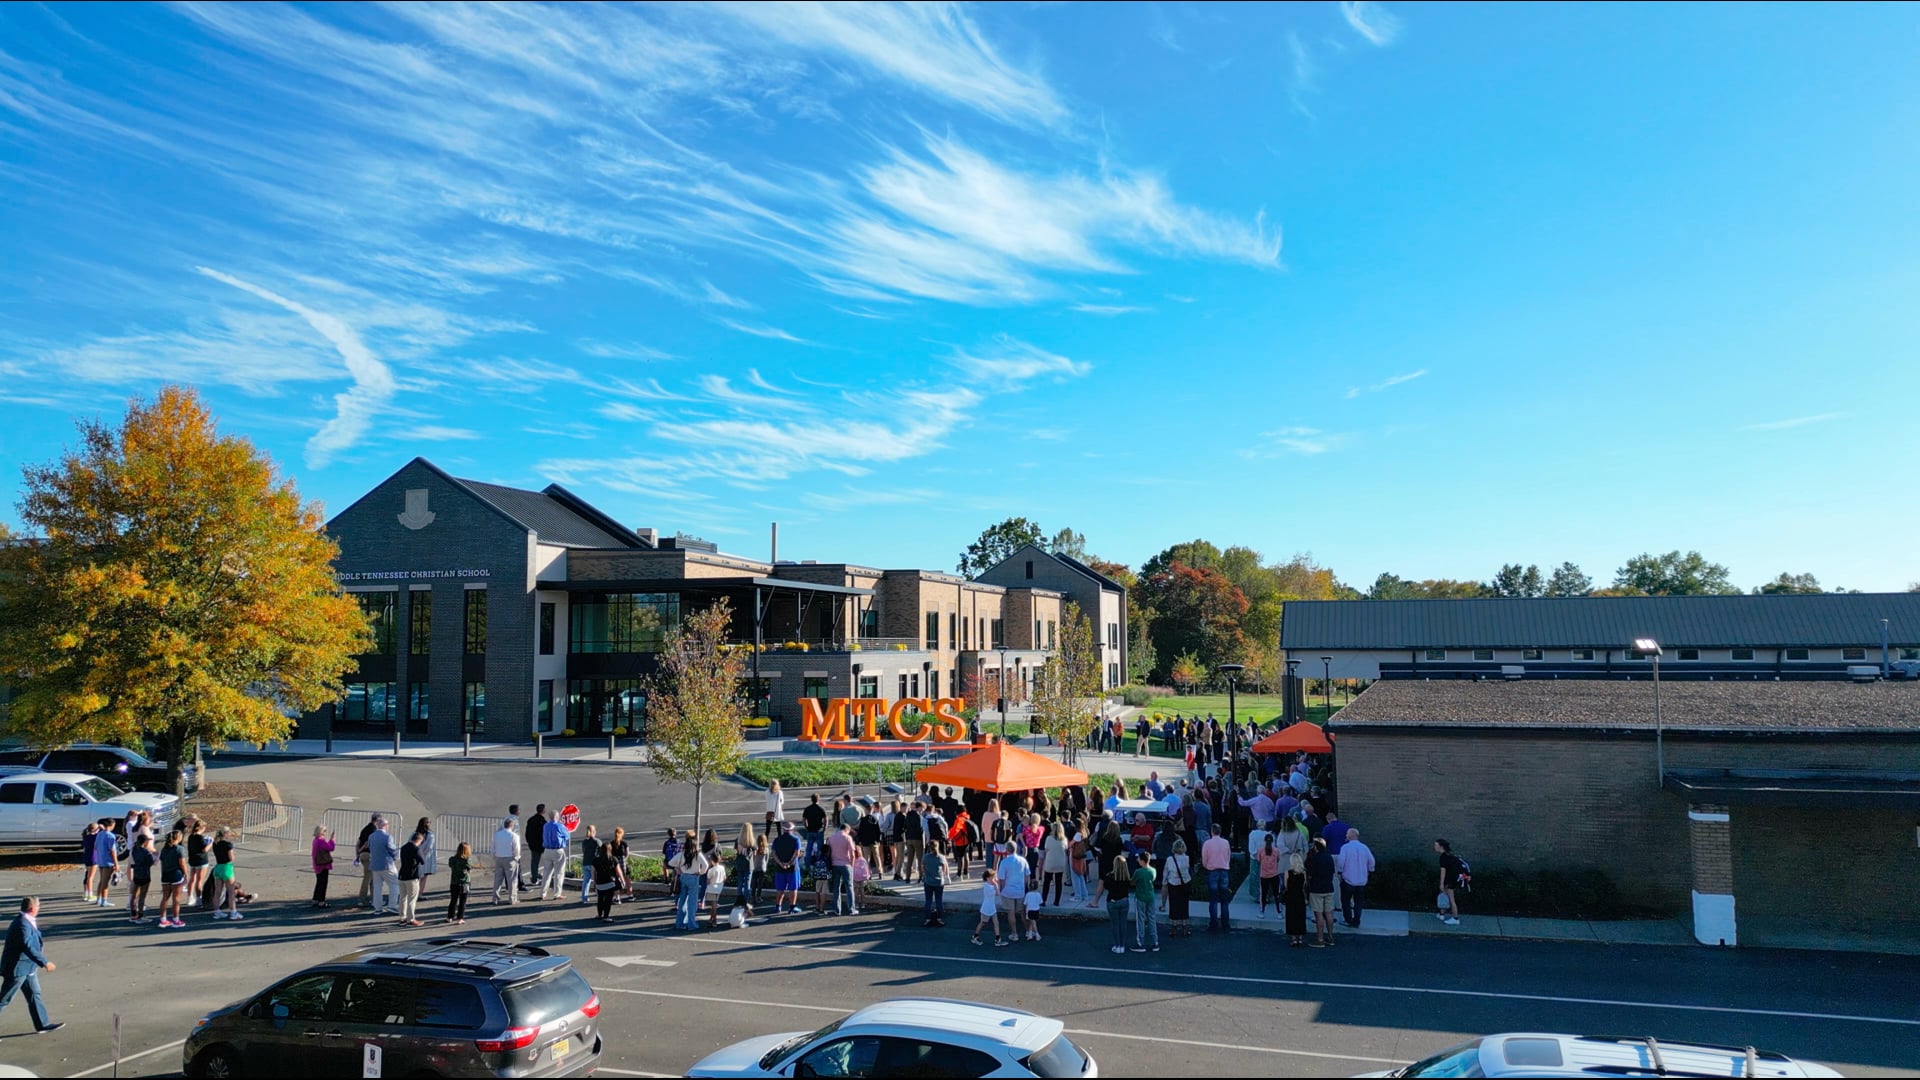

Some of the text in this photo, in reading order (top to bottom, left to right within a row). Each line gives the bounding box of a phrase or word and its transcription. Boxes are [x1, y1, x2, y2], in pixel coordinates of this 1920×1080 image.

[361, 571, 410, 580] TENNESSEE
[410, 570, 456, 579] CHRISTIAN
[457, 569, 491, 577] SCHOOL
[797, 697, 967, 743] MTCS
[561, 813, 579, 825] STOP
